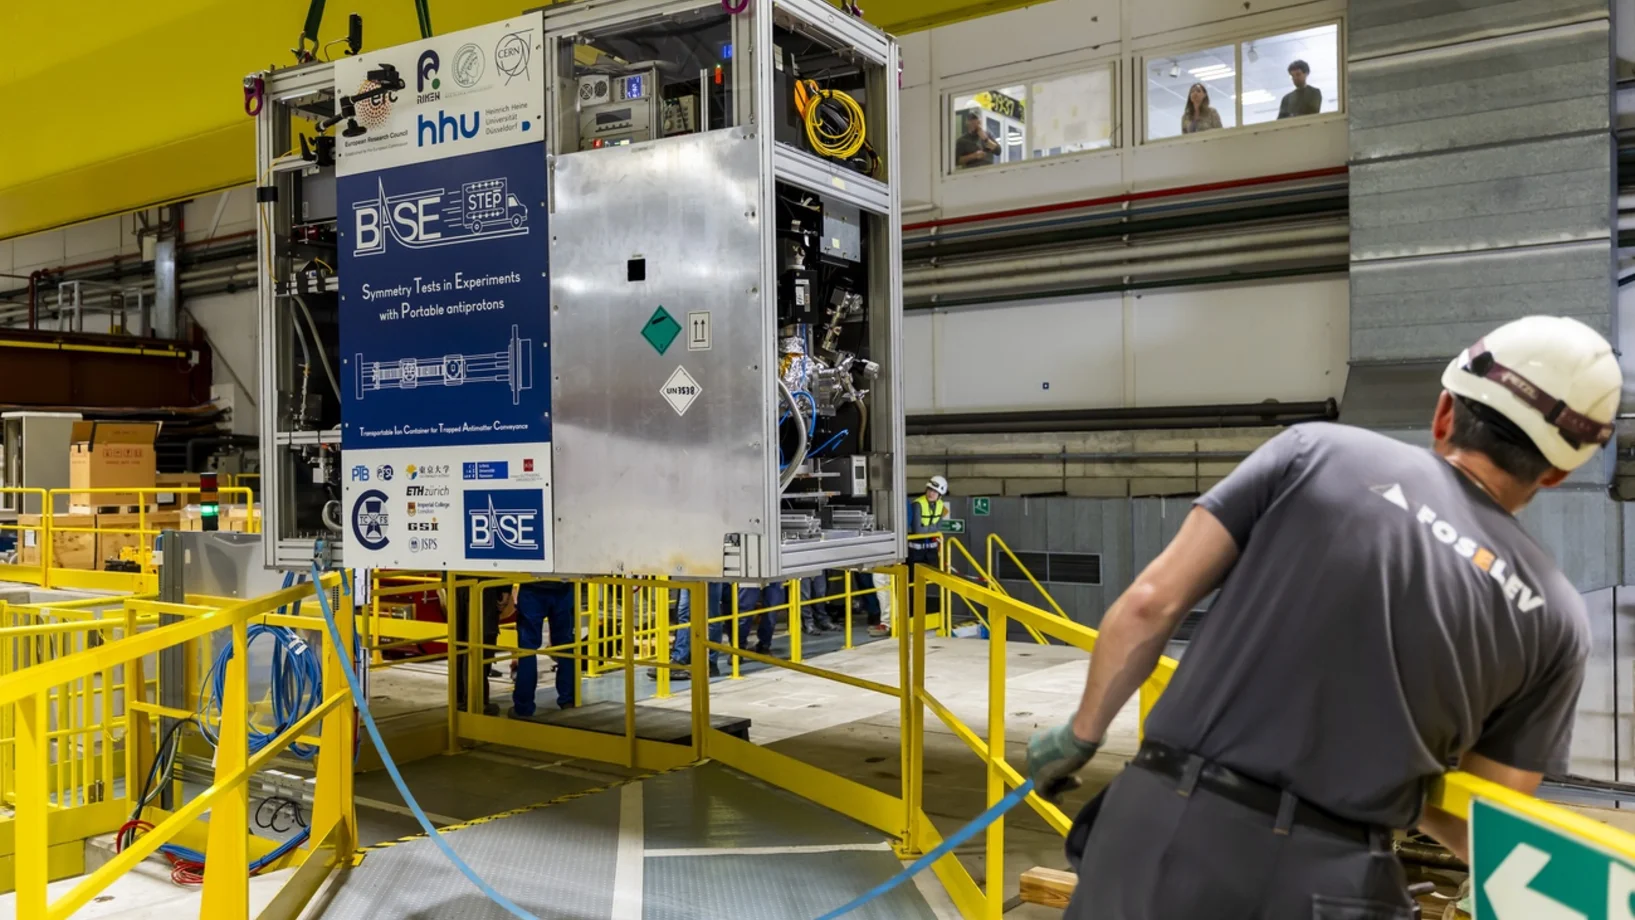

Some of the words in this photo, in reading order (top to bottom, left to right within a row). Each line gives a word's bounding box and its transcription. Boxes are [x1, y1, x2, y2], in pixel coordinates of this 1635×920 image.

[498, 46, 520, 58] CERN
[485, 105, 510, 115] Heinrich
[511, 102, 528, 110] Heine
[418, 110, 480, 147] hhu
[345, 139, 366, 148] European
[367, 134, 389, 142] Research
[390, 129, 408, 138] Council
[468, 189, 502, 211] STEP
[355, 176, 443, 252] BASE
[362, 284, 411, 301] Symmetry
[415, 277, 441, 294] Tests
[443, 279, 453, 291] in
[454, 271, 521, 290] Experiments
[379, 308, 399, 322] with
[401, 302, 444, 320] Portable
[446, 299, 505, 318] antiprotons
[360, 427, 393, 437] Transportable
[394, 425, 403, 435] Ion
[403, 424, 430, 435] Container
[438, 422, 461, 434] Trapped
[462, 421, 492, 433] Antimatter
[493, 420, 528, 431] Conveyance
[351, 465, 370, 482] PTB
[419, 464, 450, 474] 東京大学
[435, 501, 450, 509] College
[420, 537, 438, 551] JSPS
[1416, 504, 1546, 613] FOSELEV
